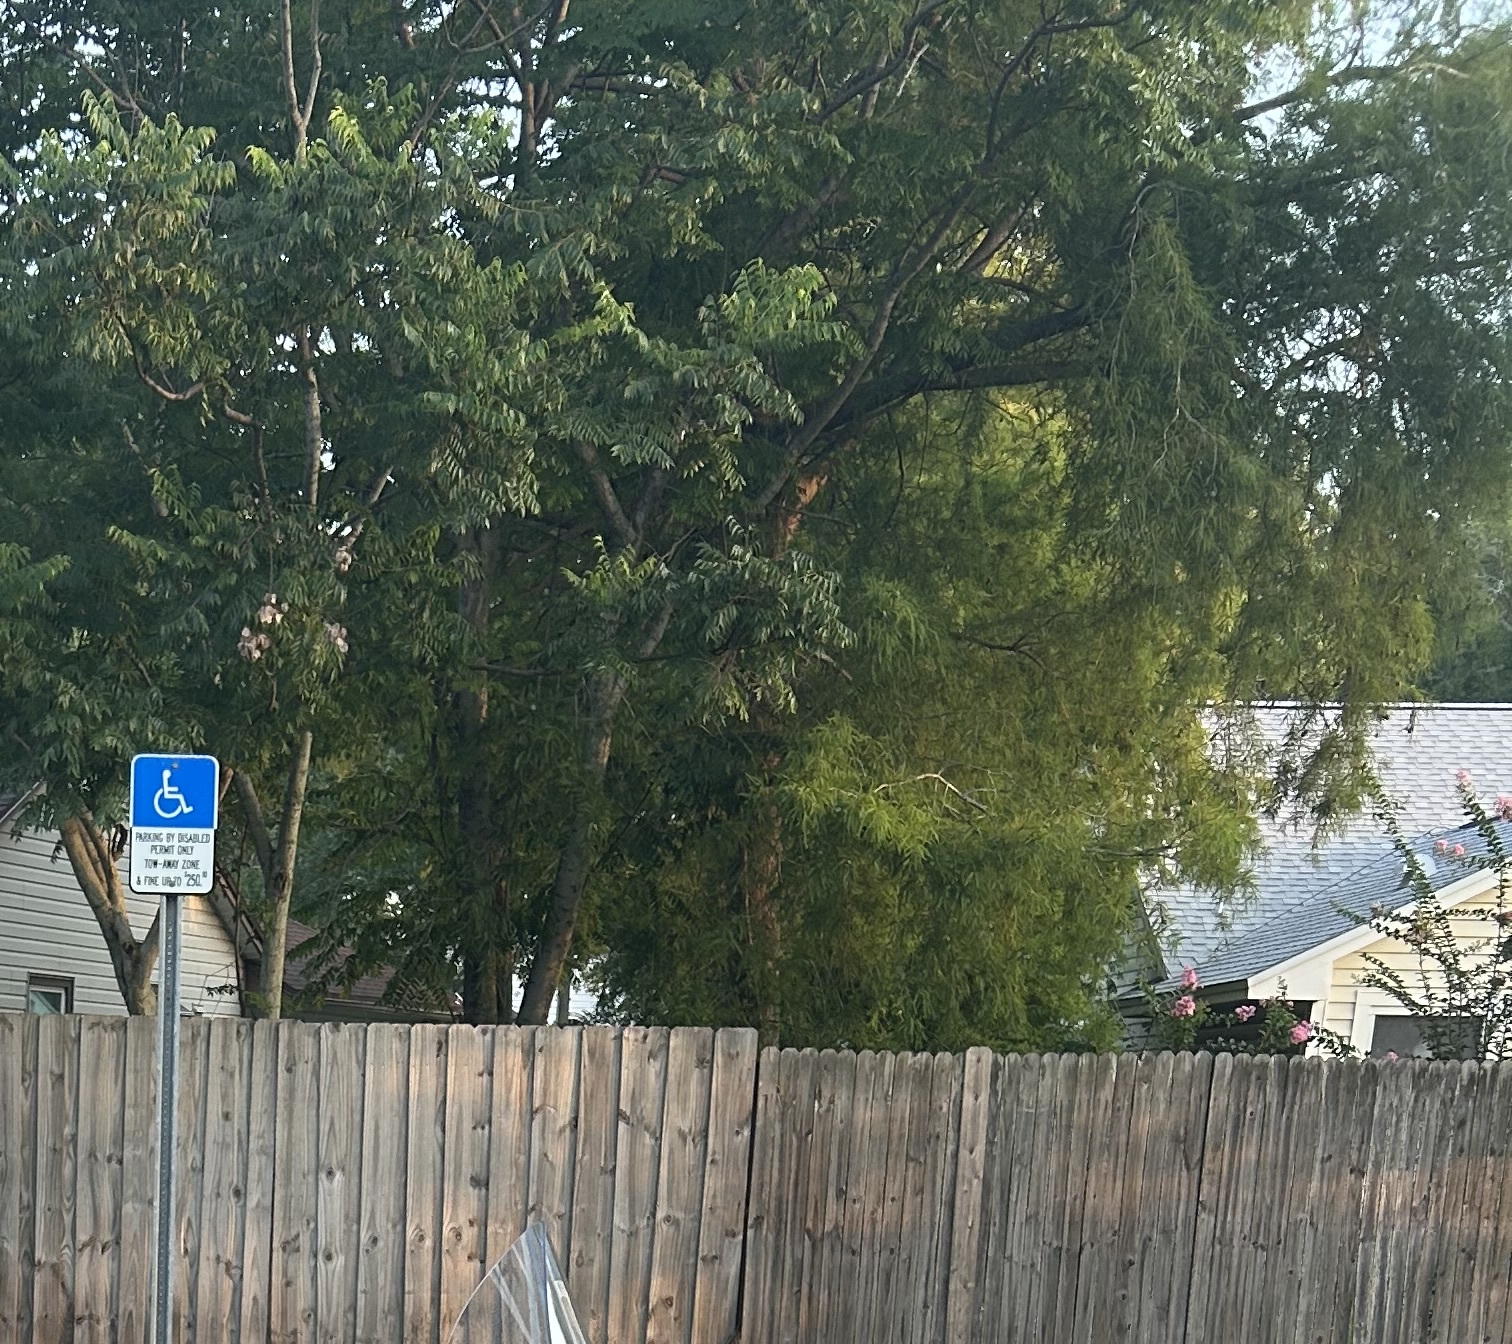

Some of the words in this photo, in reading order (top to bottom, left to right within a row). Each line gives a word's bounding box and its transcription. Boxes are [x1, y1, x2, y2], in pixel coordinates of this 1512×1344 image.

[135, 832, 163, 842] PARKING
[166, 833, 175, 843] BY
[178, 833, 210, 843] DISABLED
[150, 845, 175, 854] PERMIT
[177, 845, 194, 855] ONLY
[144, 858, 179, 869] TOW-AWAY
[182, 859, 200, 870] ZONE
[144, 876, 159, 886] FINE
